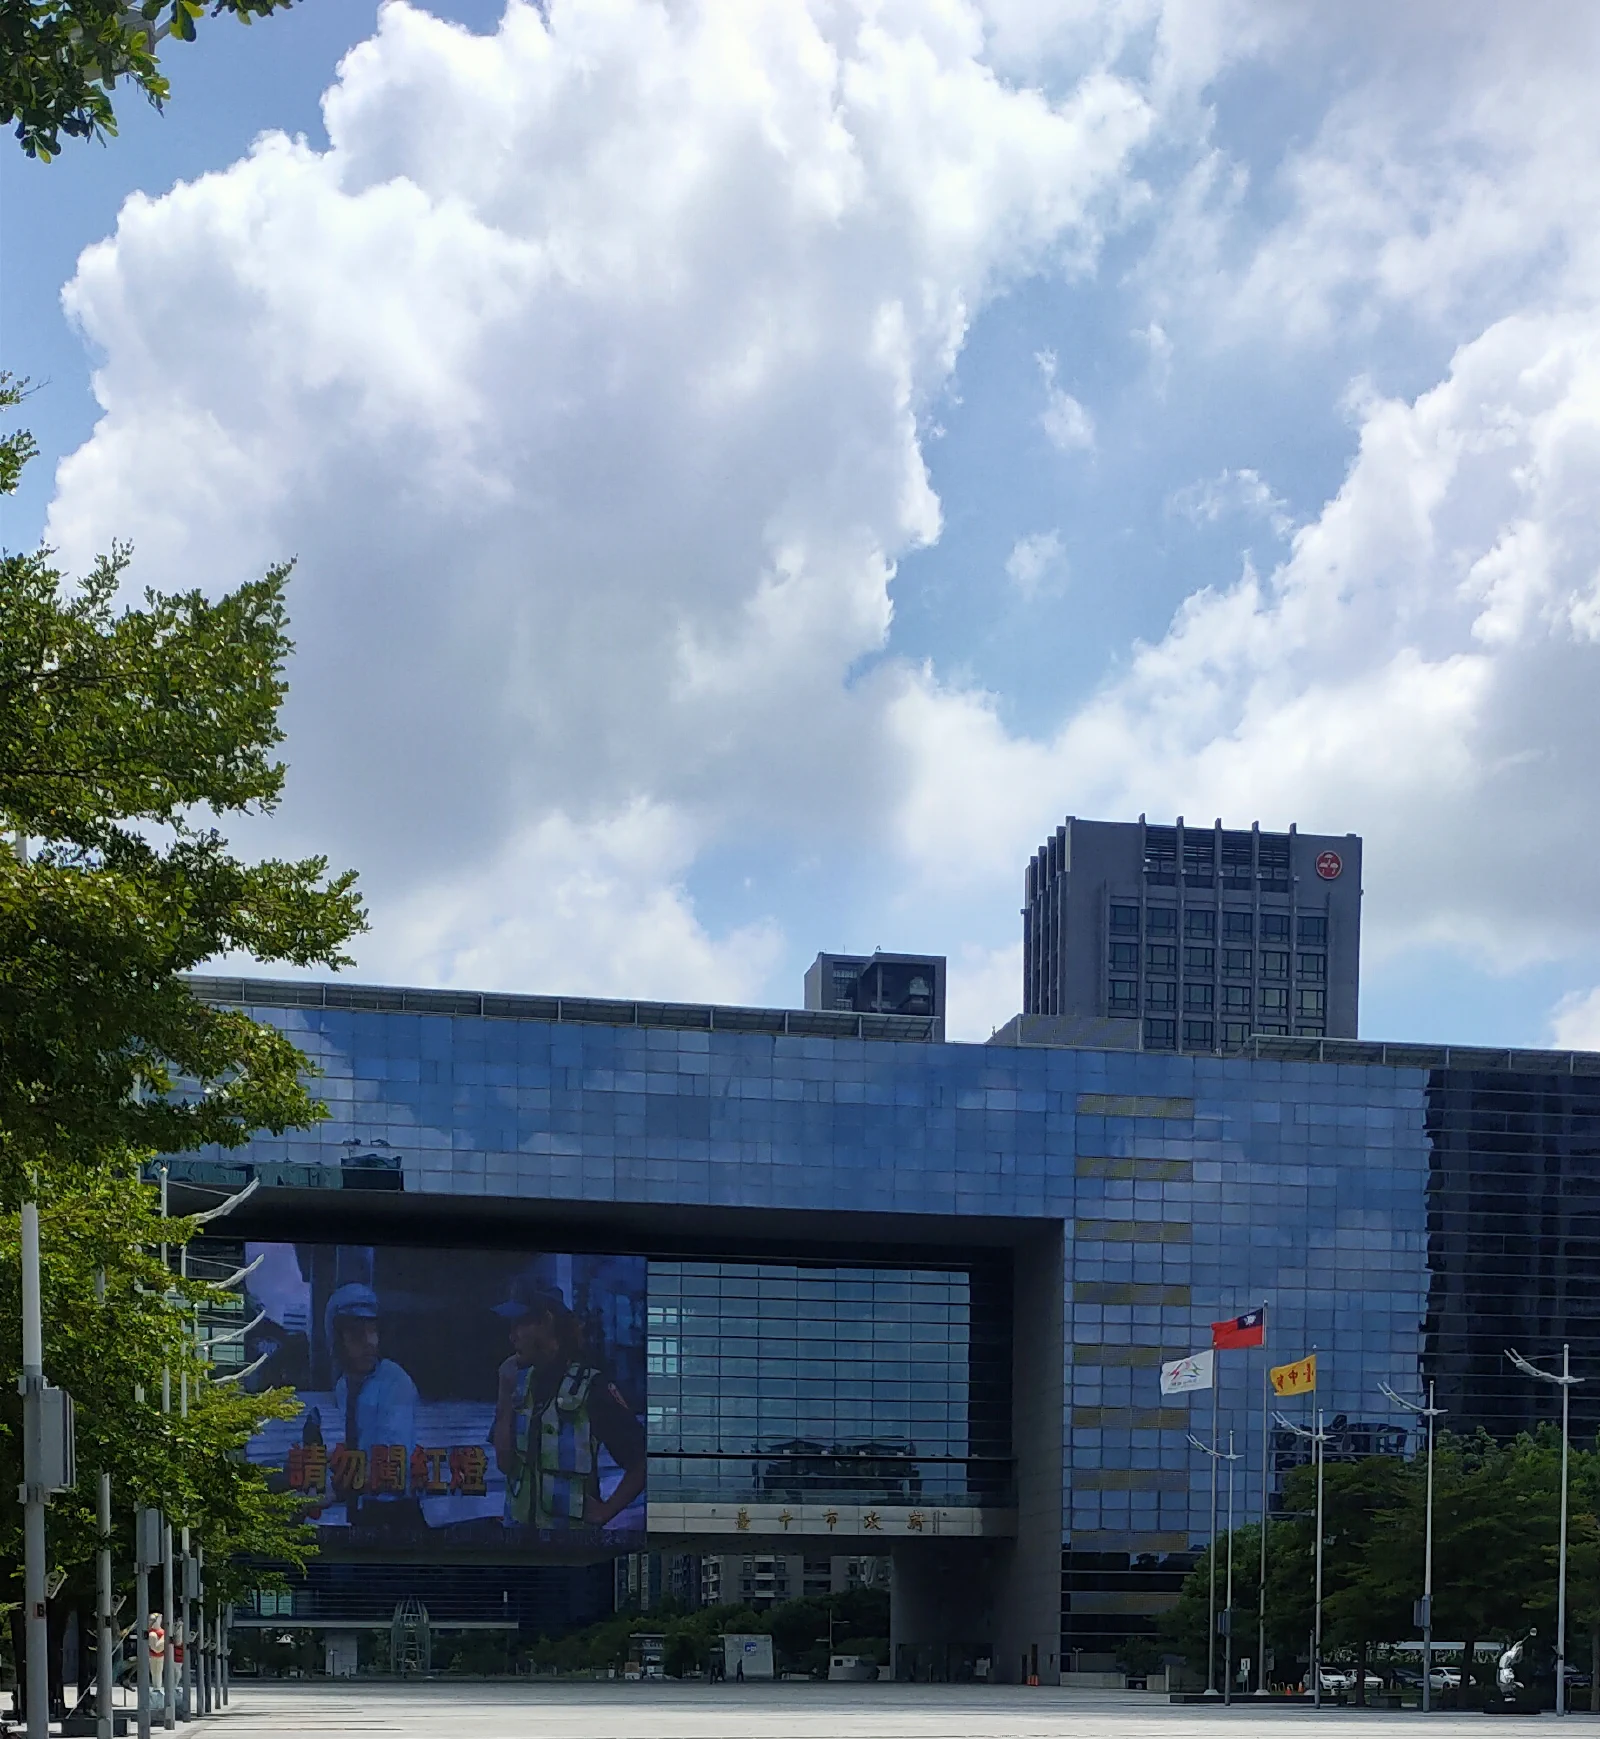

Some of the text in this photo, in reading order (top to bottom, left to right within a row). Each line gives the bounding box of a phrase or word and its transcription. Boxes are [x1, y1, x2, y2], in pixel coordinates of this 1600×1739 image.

[288, 1443, 487, 1496] 請勿闖紅燈
